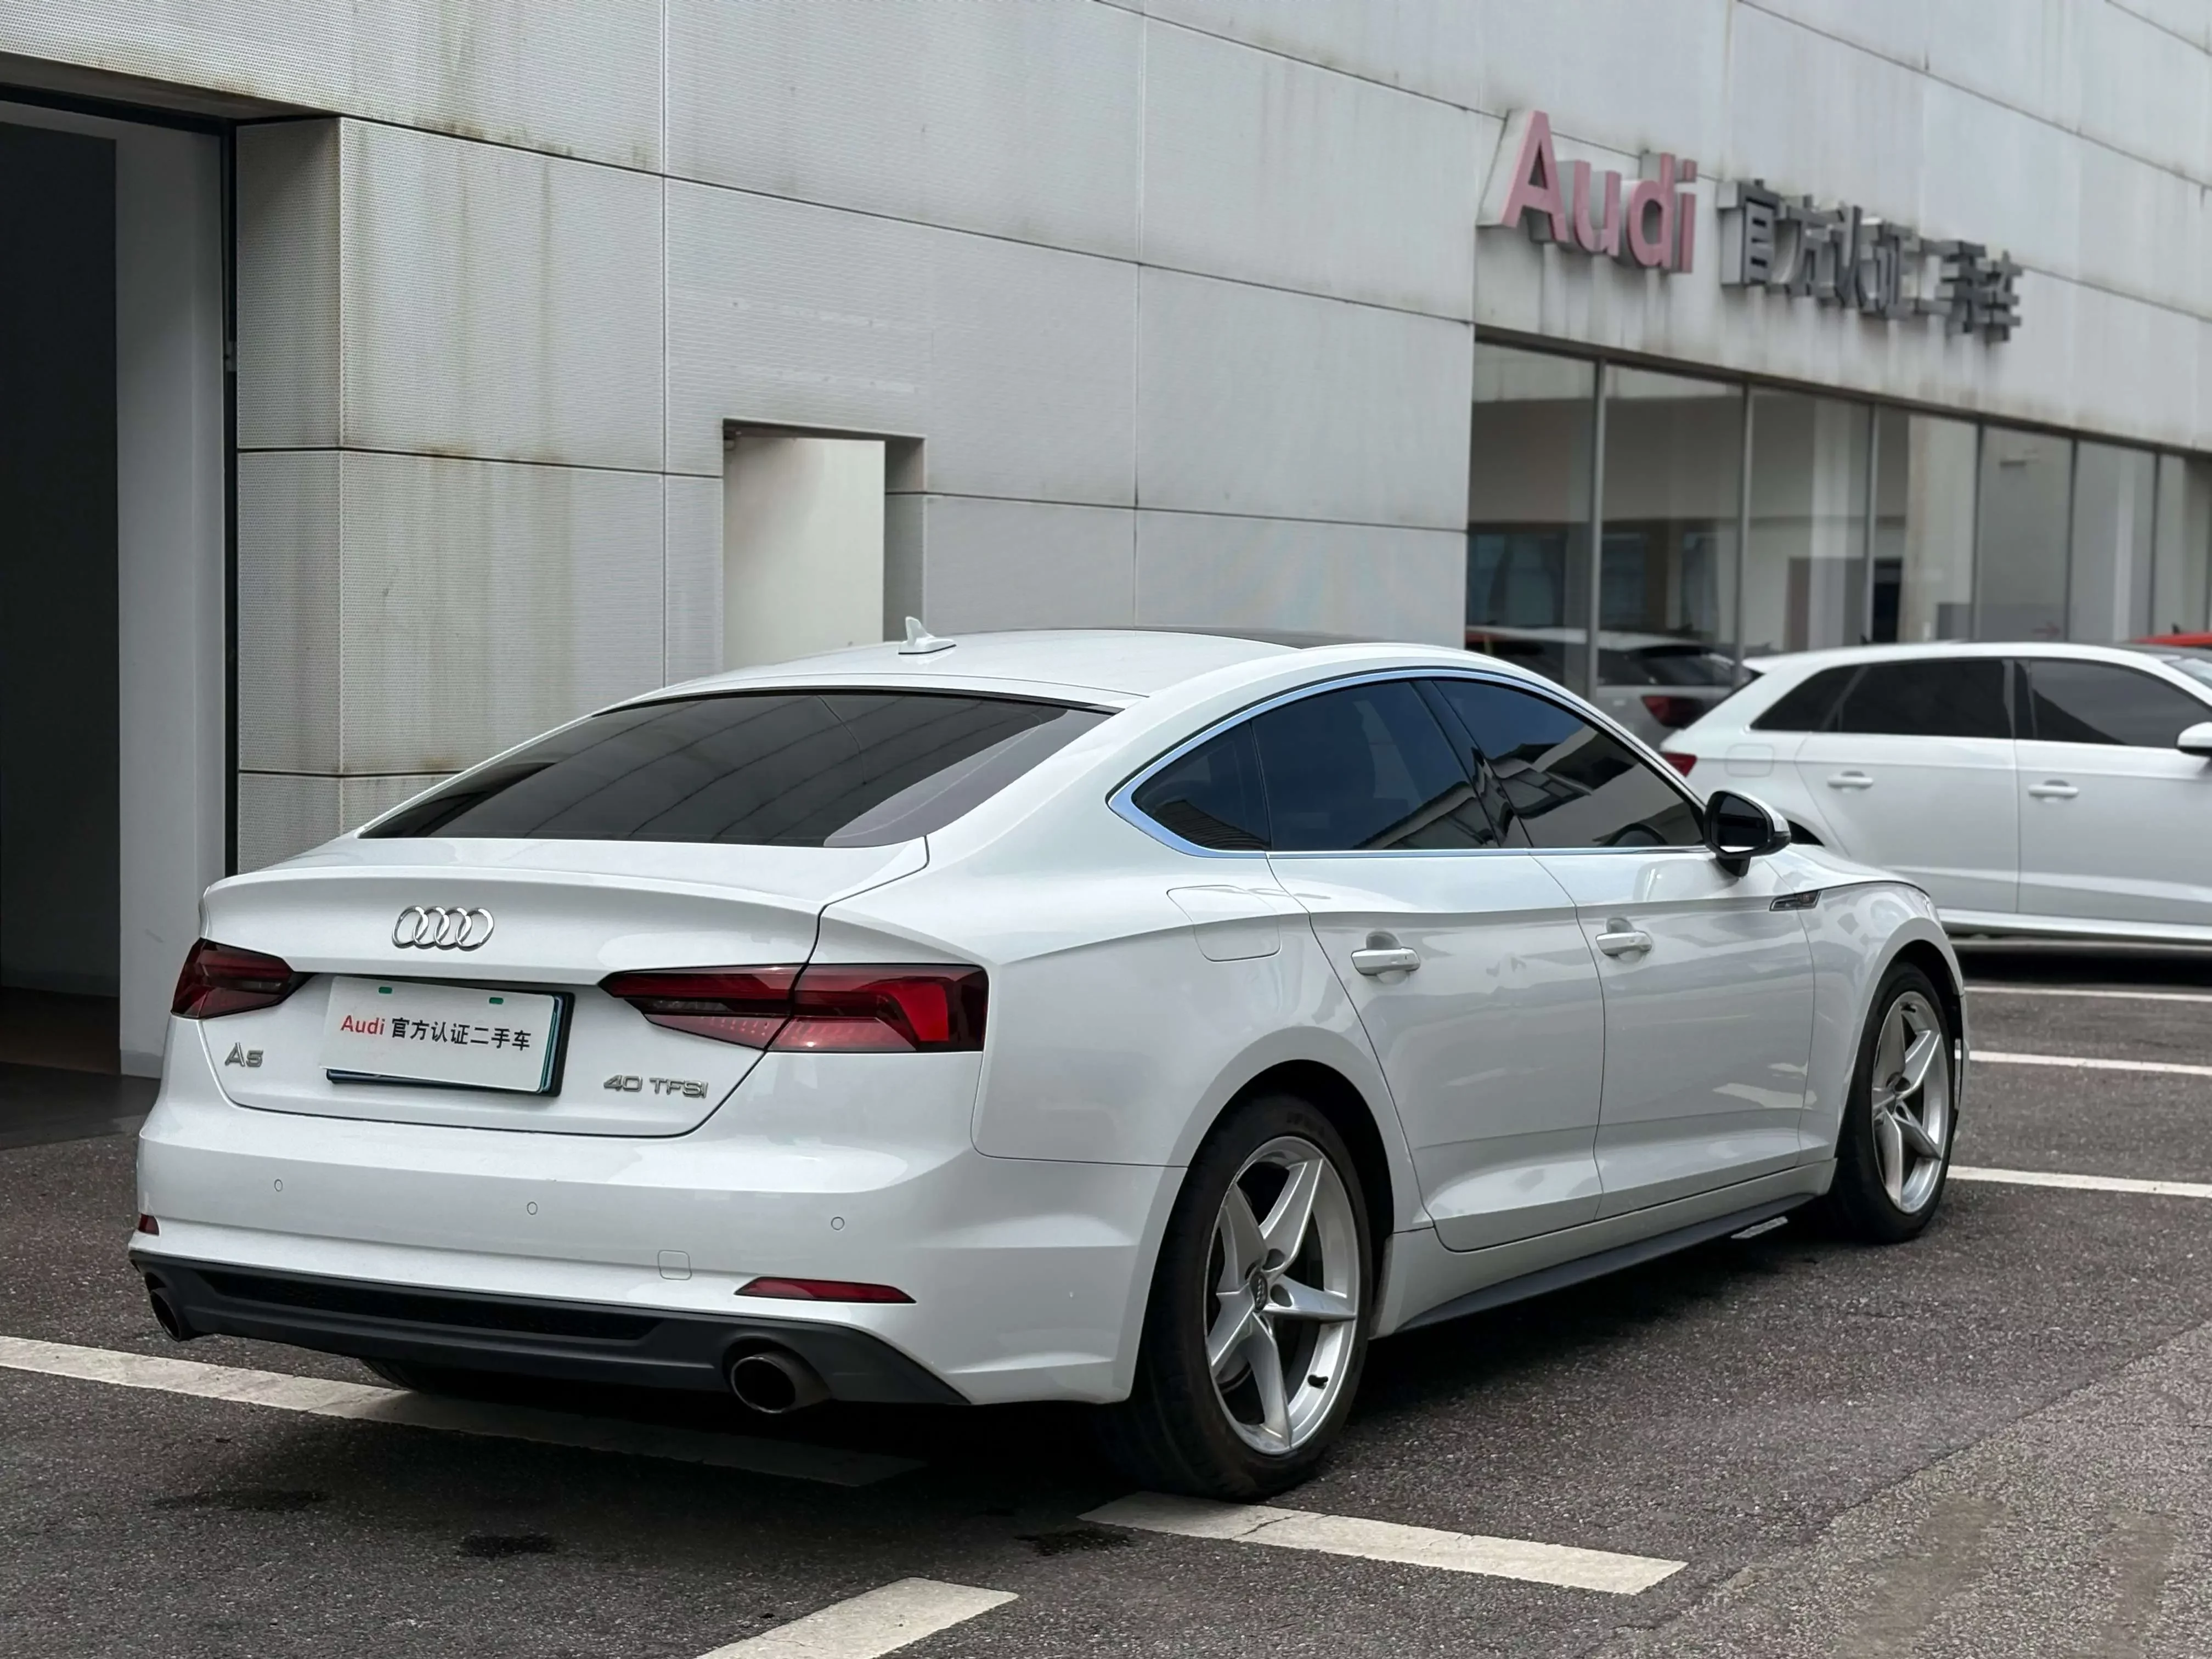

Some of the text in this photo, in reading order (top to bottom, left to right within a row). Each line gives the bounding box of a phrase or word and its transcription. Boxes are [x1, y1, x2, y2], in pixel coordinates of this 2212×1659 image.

[1501, 110, 1697, 274] Audi
[340, 1014, 532, 1050] Audi 官方认证二手车
[224, 1042, 264, 1067] A5
[603, 1075, 708, 1099] 40 TFSI
